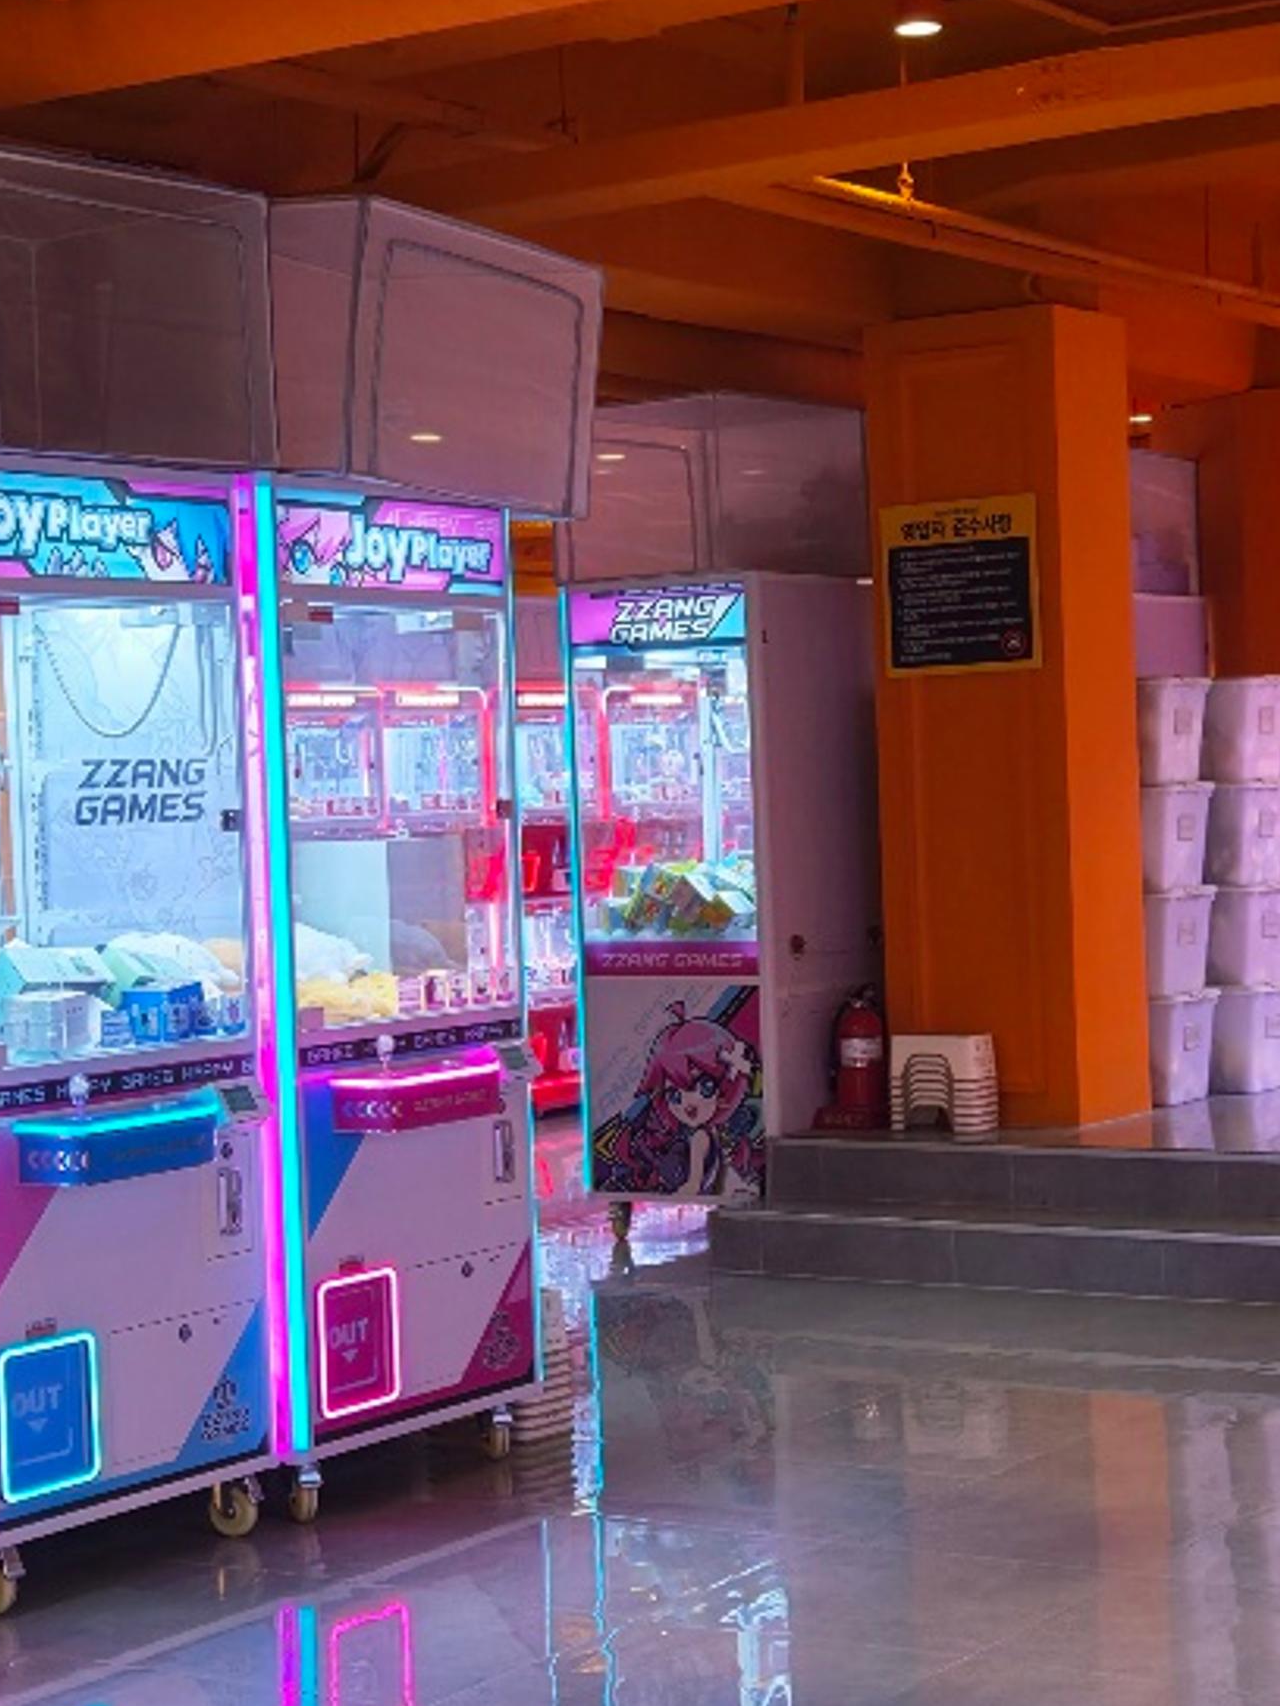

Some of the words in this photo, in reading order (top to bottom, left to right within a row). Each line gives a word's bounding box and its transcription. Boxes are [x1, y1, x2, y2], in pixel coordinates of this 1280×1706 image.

[616, 595, 718, 621] ZZANG
[611, 618, 715, 643] GAMES
[78, 759, 208, 789] ZZANG
[75, 791, 208, 826] GAMES
[601, 953, 669, 968] ZZANG
